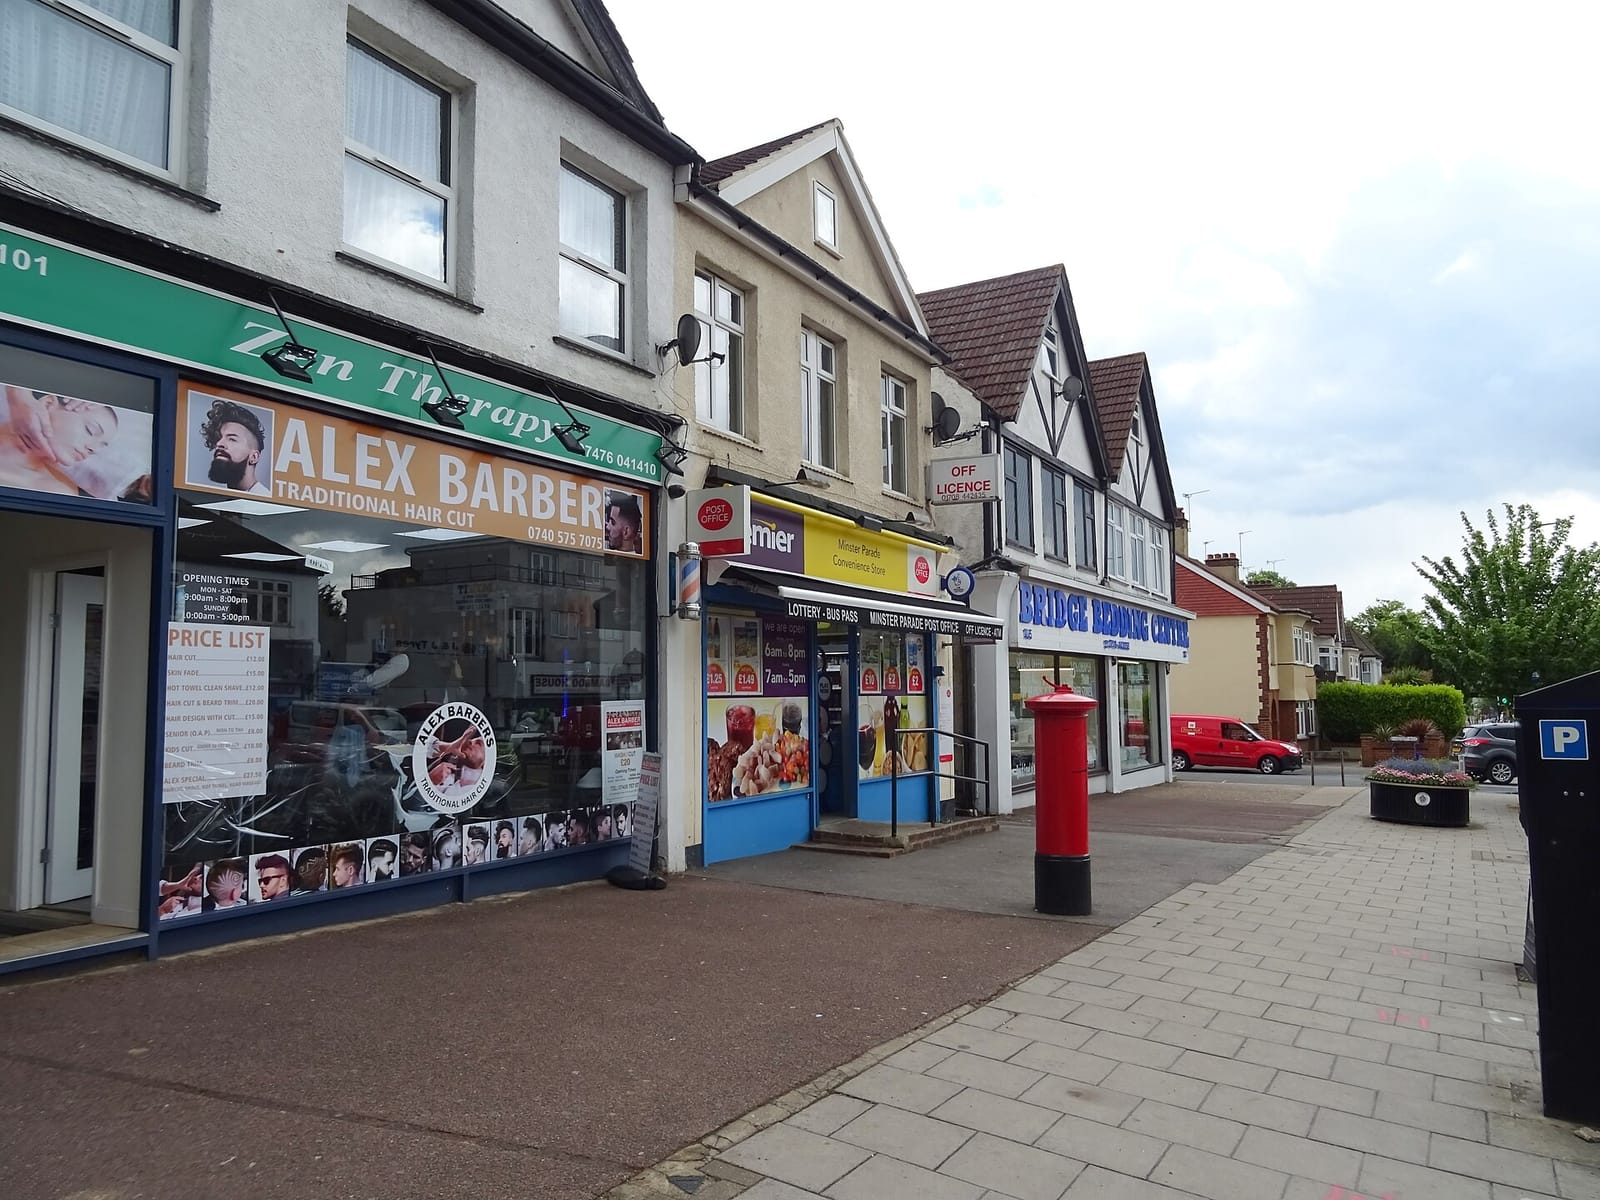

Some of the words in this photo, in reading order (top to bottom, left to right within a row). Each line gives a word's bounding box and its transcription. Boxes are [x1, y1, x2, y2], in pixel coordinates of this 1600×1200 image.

[230, 321, 354, 382] Zn
[579, 442, 613, 464] 7476
[617, 455, 656, 475] 041410
[275, 418, 416, 496] ALEX
[439, 454, 602, 530] BARBER
[951, 464, 976, 478] OFF
[936, 480, 991, 495] LICENCE
[275, 480, 399, 517] TRADITIONAL
[405, 502, 441, 523] HAIR
[447, 510, 475, 528] CUT
[705, 504, 725, 515] POST
[701, 512, 729, 523] OFFICE
[528, 526, 554, 543] 0740
[557, 530, 576, 546] 575
[579, 533, 602, 550] 7075
[750, 523, 795, 553] mier
[838, 538, 861, 554] Minster
[861, 545, 881, 559] Parade
[833, 554, 869, 573] Convenience
[871, 562, 886, 576] Store
[915, 568, 929, 578] OFFICE
[917, 561, 927, 570] POST
[183, 573, 222, 584] OPENING
[224, 576, 250, 586] TIMES
[204, 604, 229, 612] SUNDAY
[220, 595, 248, 605] 8:00pm
[183, 611, 215, 620] 0:00am
[222, 613, 250, 622] 5:00pm
[788, 602, 821, 618] LOTTERY
[826, 606, 840, 620] BUS
[841, 608, 858, 623] PASS
[870, 611, 898, 627] MINSTER
[900, 615, 924, 630] PARADE
[924, 618, 939, 632] POST
[940, 619, 959, 634] OFFICE
[1019, 581, 1089, 632] BRIDGE
[1092, 599, 1149, 641] BEDDING
[1151, 614, 1190, 648] CENTRE
[168, 628, 222, 648] PRICE
[229, 631, 265, 648] LIST
[764, 623, 775, 632] we
[776, 624, 788, 633] are
[966, 624, 974, 635] OFF
[975, 626, 992, 637] LICENCE
[764, 643, 782, 657] 6am
[788, 643, 806, 662] 8pm
[765, 669, 782, 684] 7am
[788, 669, 806, 688] 5pm
[418, 710, 444, 746] ALEX
[448, 706, 494, 748] BARBERS
[1552, 726, 1580, 752] P
[420, 778, 460, 808] TRADITIONAL
[462, 791, 477, 806] HAIR
[476, 778, 488, 793] CUT
